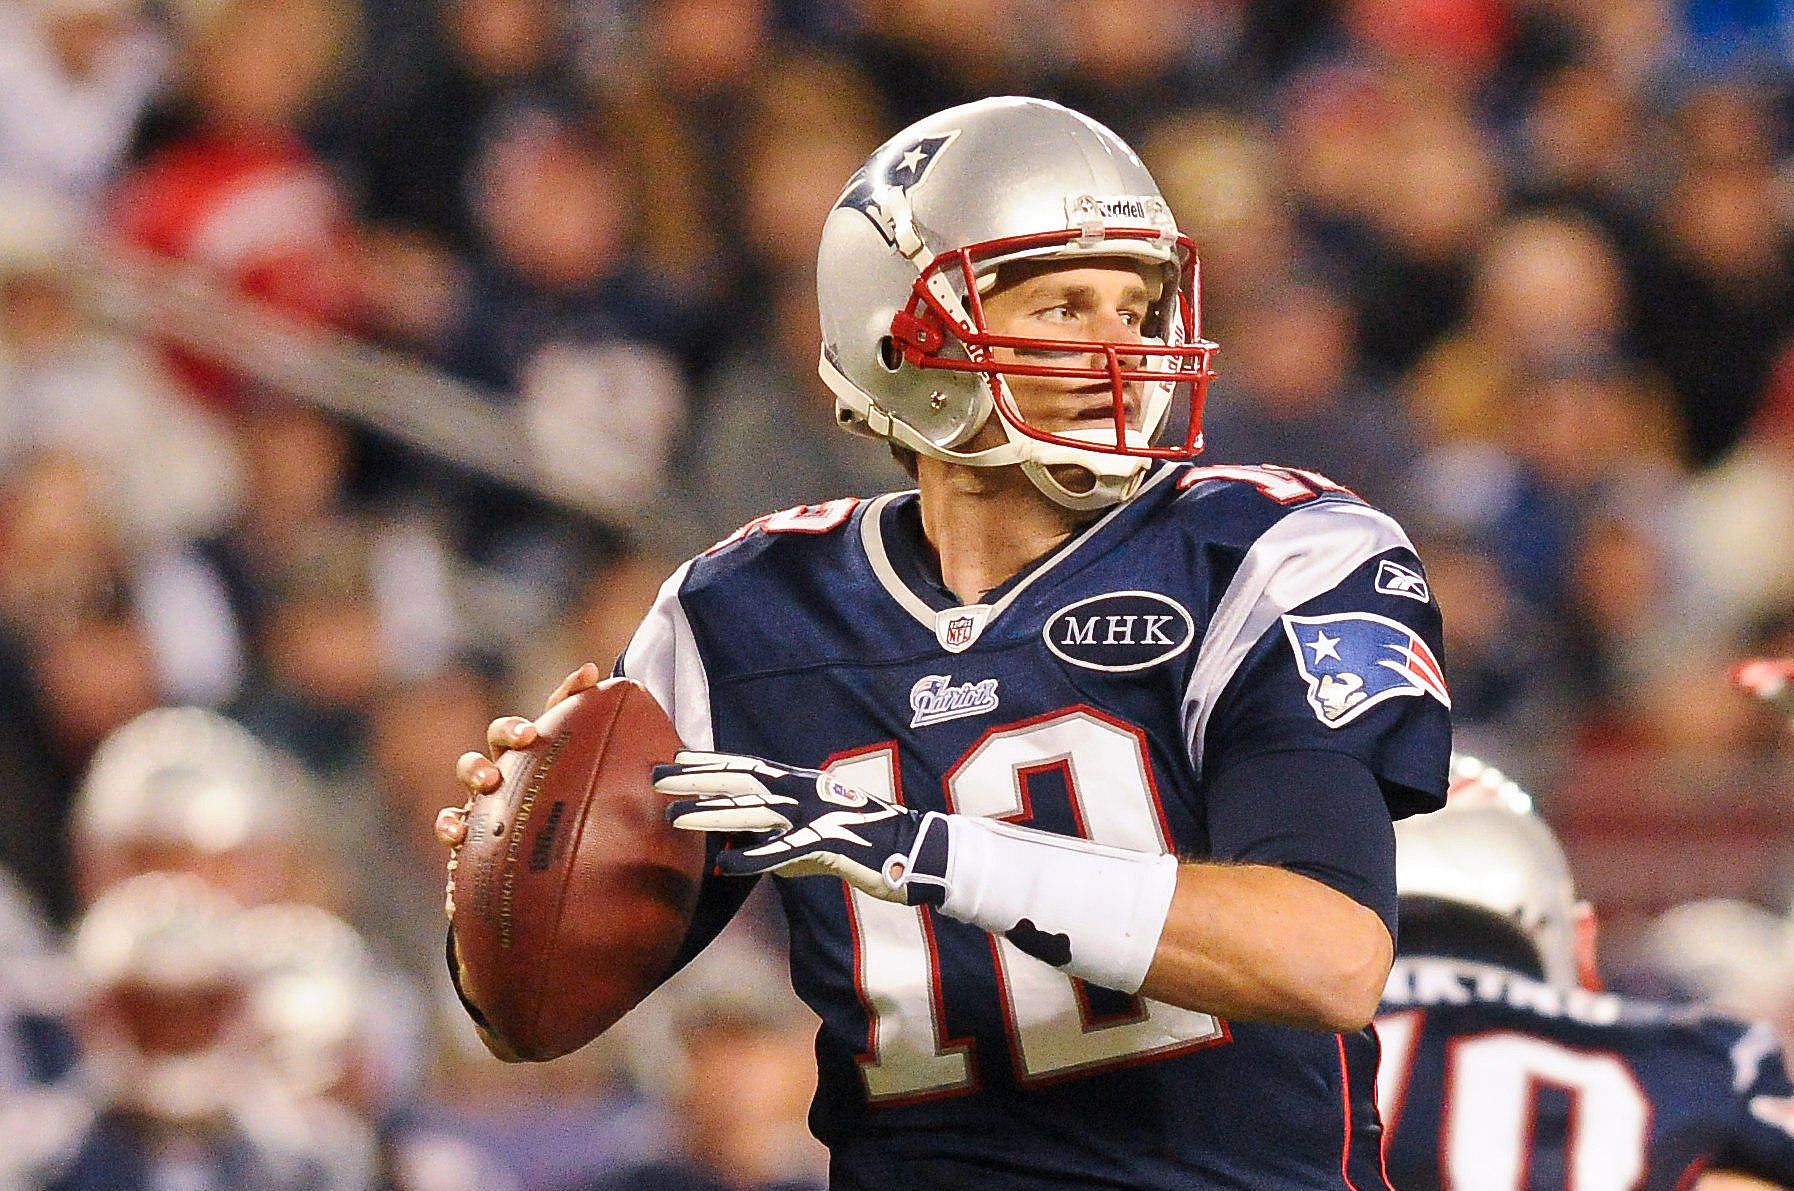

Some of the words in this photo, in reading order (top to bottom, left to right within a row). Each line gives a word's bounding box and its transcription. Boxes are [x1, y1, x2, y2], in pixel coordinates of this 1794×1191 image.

[1060, 614, 1176, 646] MHK
[911, 676, 999, 727] Patriots
[507, 784, 541, 863] FOOTBALL
[820, 703, 1234, 1108] 12
